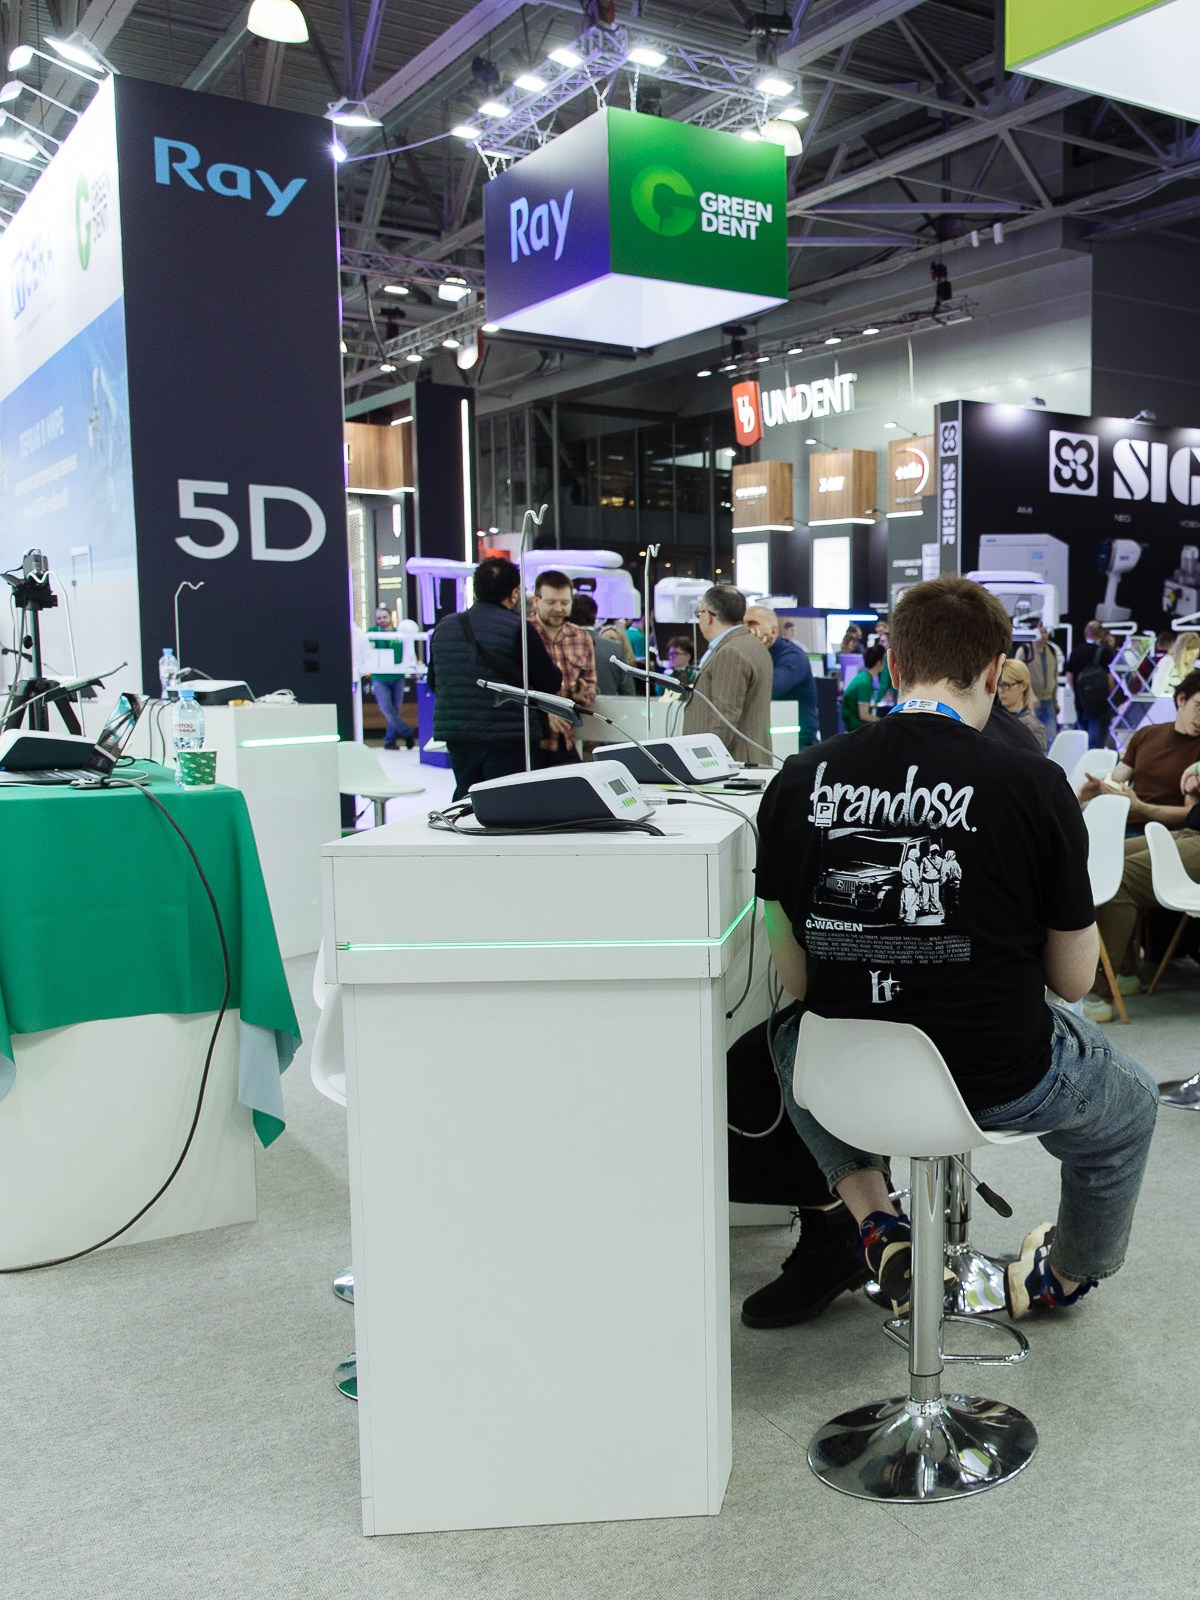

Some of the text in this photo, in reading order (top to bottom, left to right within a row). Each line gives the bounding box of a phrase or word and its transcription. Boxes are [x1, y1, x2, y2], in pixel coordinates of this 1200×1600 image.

[153, 136, 308, 218] Ray
[509, 188, 574, 264] Ray
[699, 190, 773, 225] GREEN
[700, 213, 760, 241] DENT
[175, 478, 328, 562] 5D
[942, 462, 956, 546] SIGER
[819, 805, 831, 815] P
[806, 919, 863, 932] G-WAGEN
